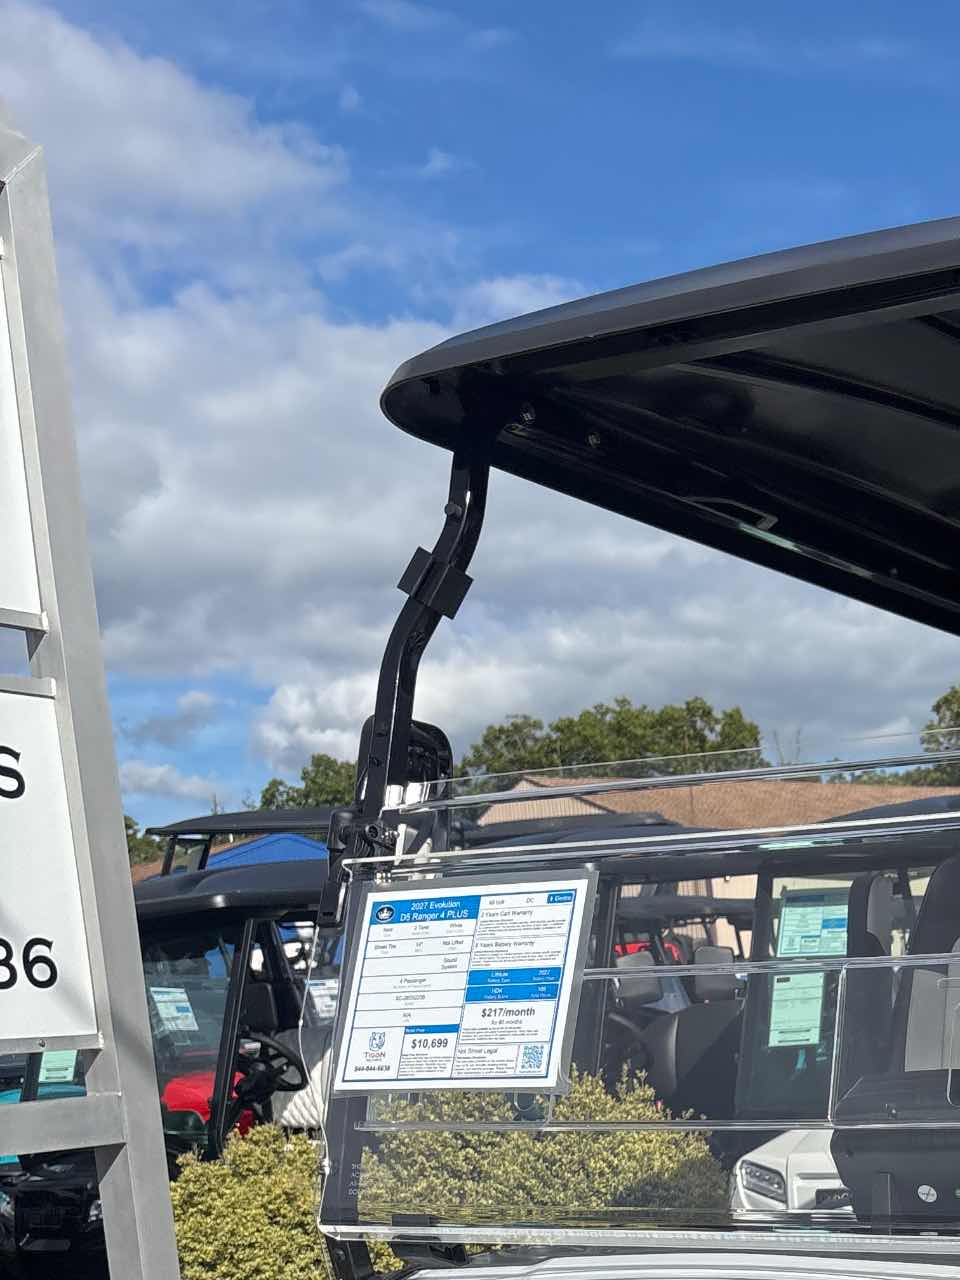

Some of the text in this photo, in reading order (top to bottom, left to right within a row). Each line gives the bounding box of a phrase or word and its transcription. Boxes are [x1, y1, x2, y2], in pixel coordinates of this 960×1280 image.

[411, 900, 460, 911] 2027 Evolution
[400, 913, 411, 921] D5
[412, 912, 439, 922] Ranger
[447, 909, 469, 918] PLUS
[481, 1007, 536, 1018] $217/month
[411, 1038, 449, 1050] $10,699
